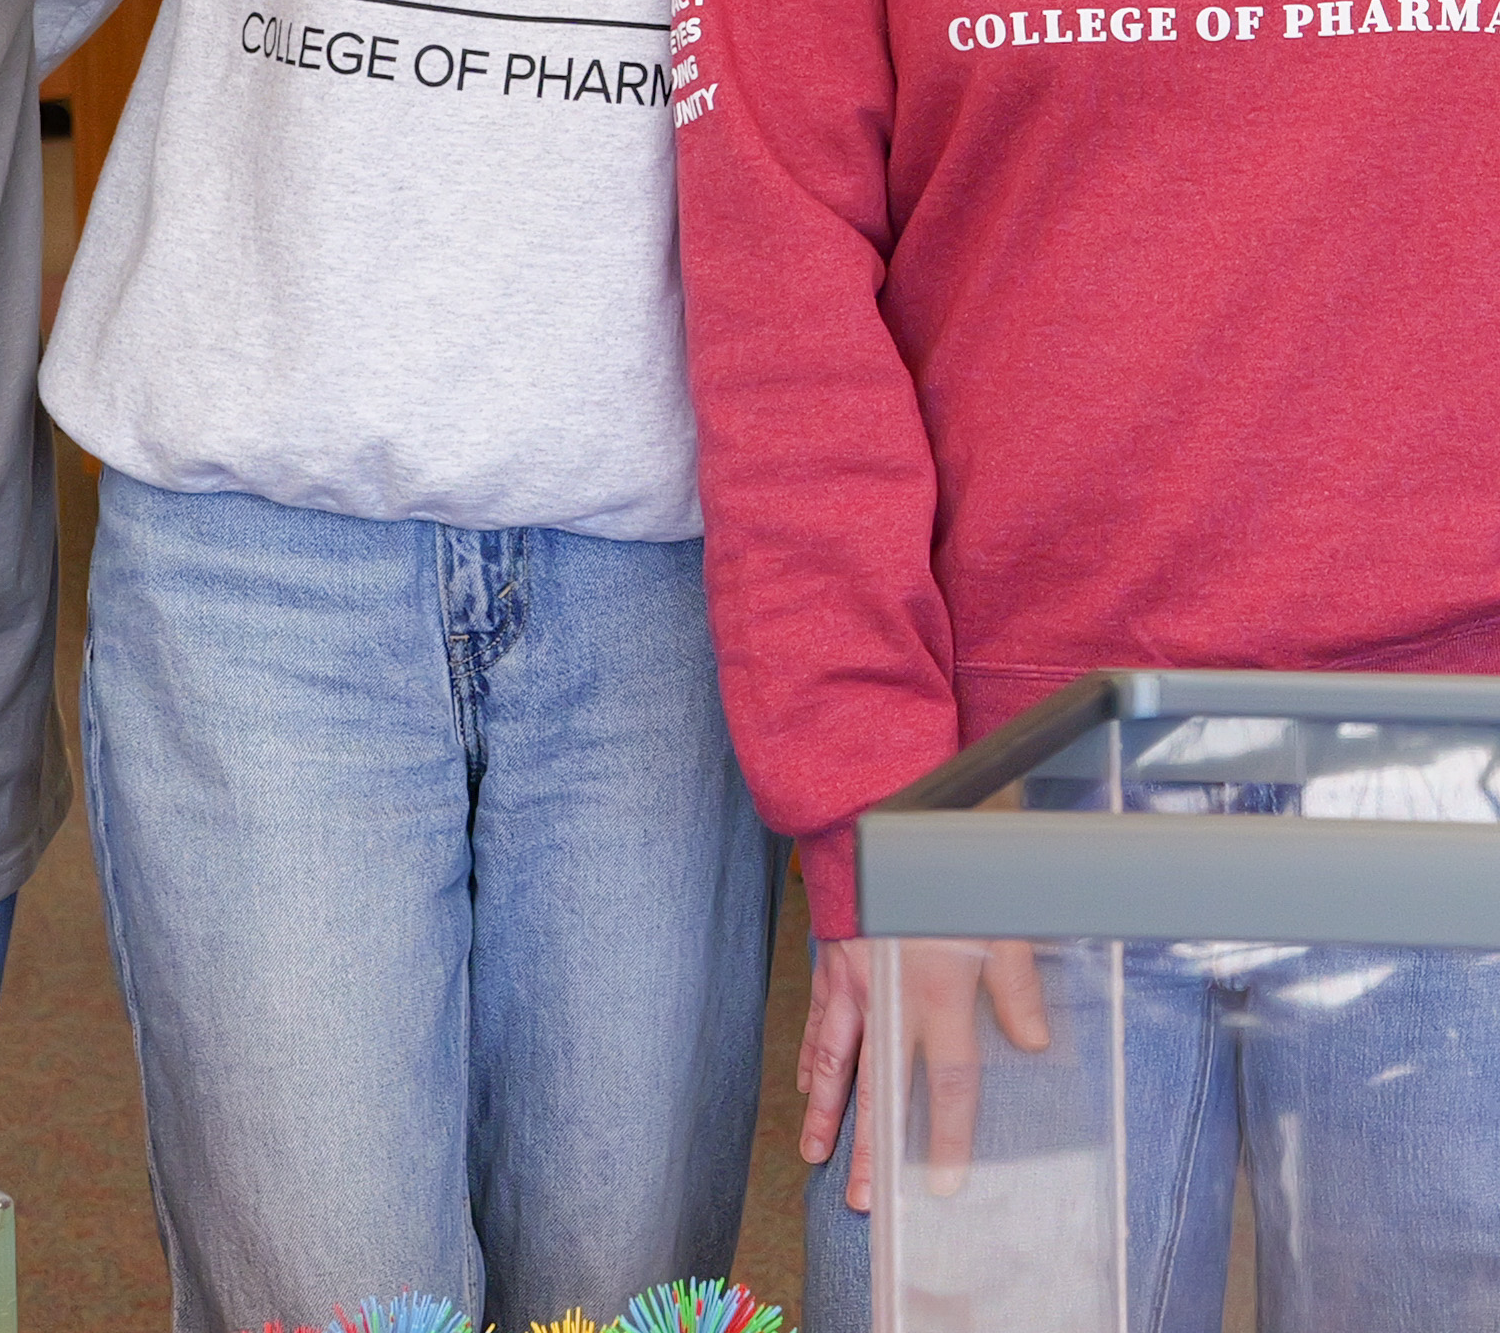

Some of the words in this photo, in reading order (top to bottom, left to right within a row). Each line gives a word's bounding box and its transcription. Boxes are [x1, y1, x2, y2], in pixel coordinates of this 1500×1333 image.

[947, 6, 1177, 52] COLLEGE
[1195, 4, 1264, 43] OF
[242, 12, 399, 82] COLLEGE
[414, 43, 488, 93] OF
[504, 53, 674, 108] PHARM
[673, 83, 719, 128] UNITY
